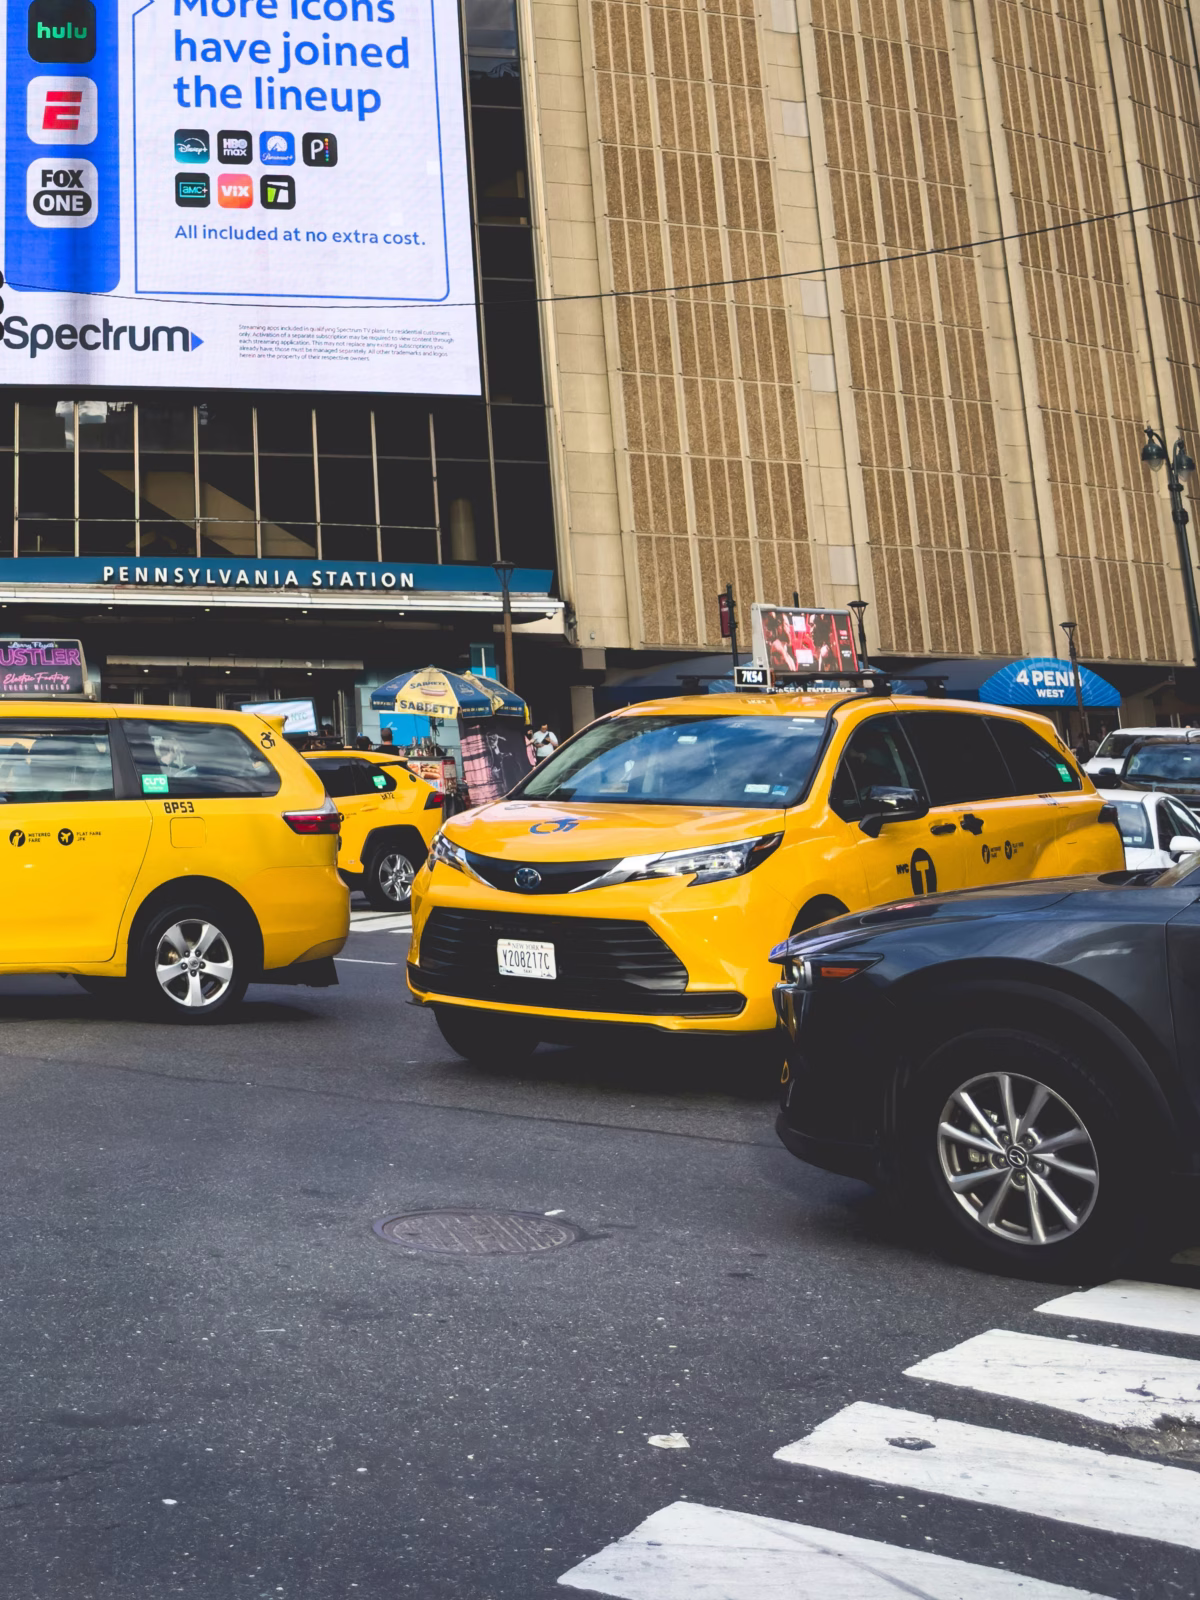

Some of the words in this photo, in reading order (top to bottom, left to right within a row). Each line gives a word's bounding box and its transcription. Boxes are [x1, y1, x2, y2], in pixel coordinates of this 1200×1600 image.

[37, 22, 87, 39] hulu
[175, 29, 271, 64] have
[278, 31, 410, 74] joined
[173, 75, 242, 109] the
[255, 76, 381, 121] lineup
[223, 138, 248, 148] HBO
[223, 148, 247, 157] max
[41, 169, 84, 188] FOX
[39, 194, 84, 212] ONE
[175, 225, 197, 239] All
[202, 225, 278, 241] included
[283, 228, 301, 241] at
[306, 229, 327, 242] no
[332, 229, 378, 244] extra
[383, 231, 426, 245] cost.
[3, 316, 189, 358] Spectrum
[103, 566, 298, 586] PENNSYLVANIA
[312, 570, 415, 588] STATION
[742, 671, 763, 683] 7K54
[1016, 670, 1030, 686] 4
[1036, 688, 1065, 698] WEST
[400, 699, 455, 715] SABRETT
[144, 777, 166, 785] curb
[164, 802, 194, 813] 8P53
[896, 864, 909, 874] NYC
[502, 949, 550, 970] Y208217C
